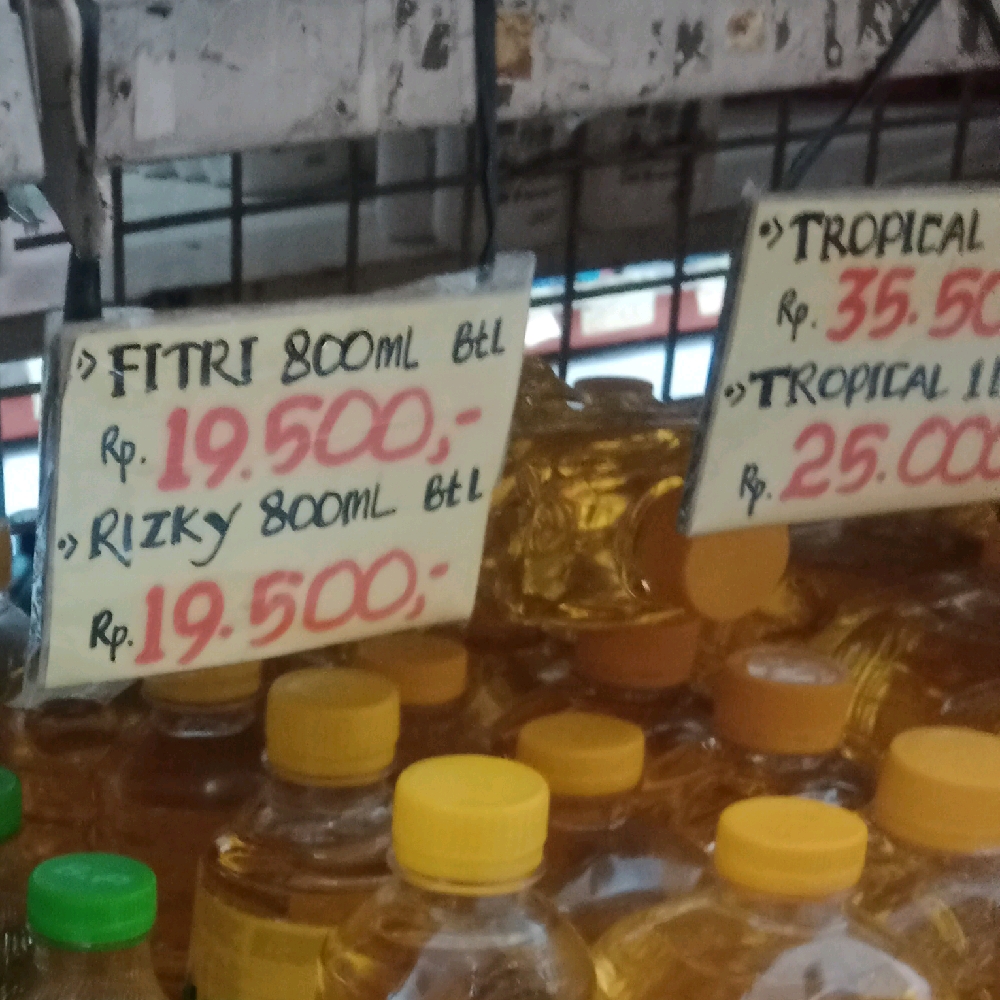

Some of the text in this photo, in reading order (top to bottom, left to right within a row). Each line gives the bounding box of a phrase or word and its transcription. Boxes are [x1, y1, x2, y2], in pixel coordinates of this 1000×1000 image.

[790, 207, 985, 263] TROPICAL
[108, 335, 258, 397] FITRI
[749, 360, 949, 409] TROPICAL
[101, 387, 482, 492] Rp. 19.500,-
[89, 503, 242, 569] RIZKY
[90, 548, 450, 666] Rp. 19.500,-
